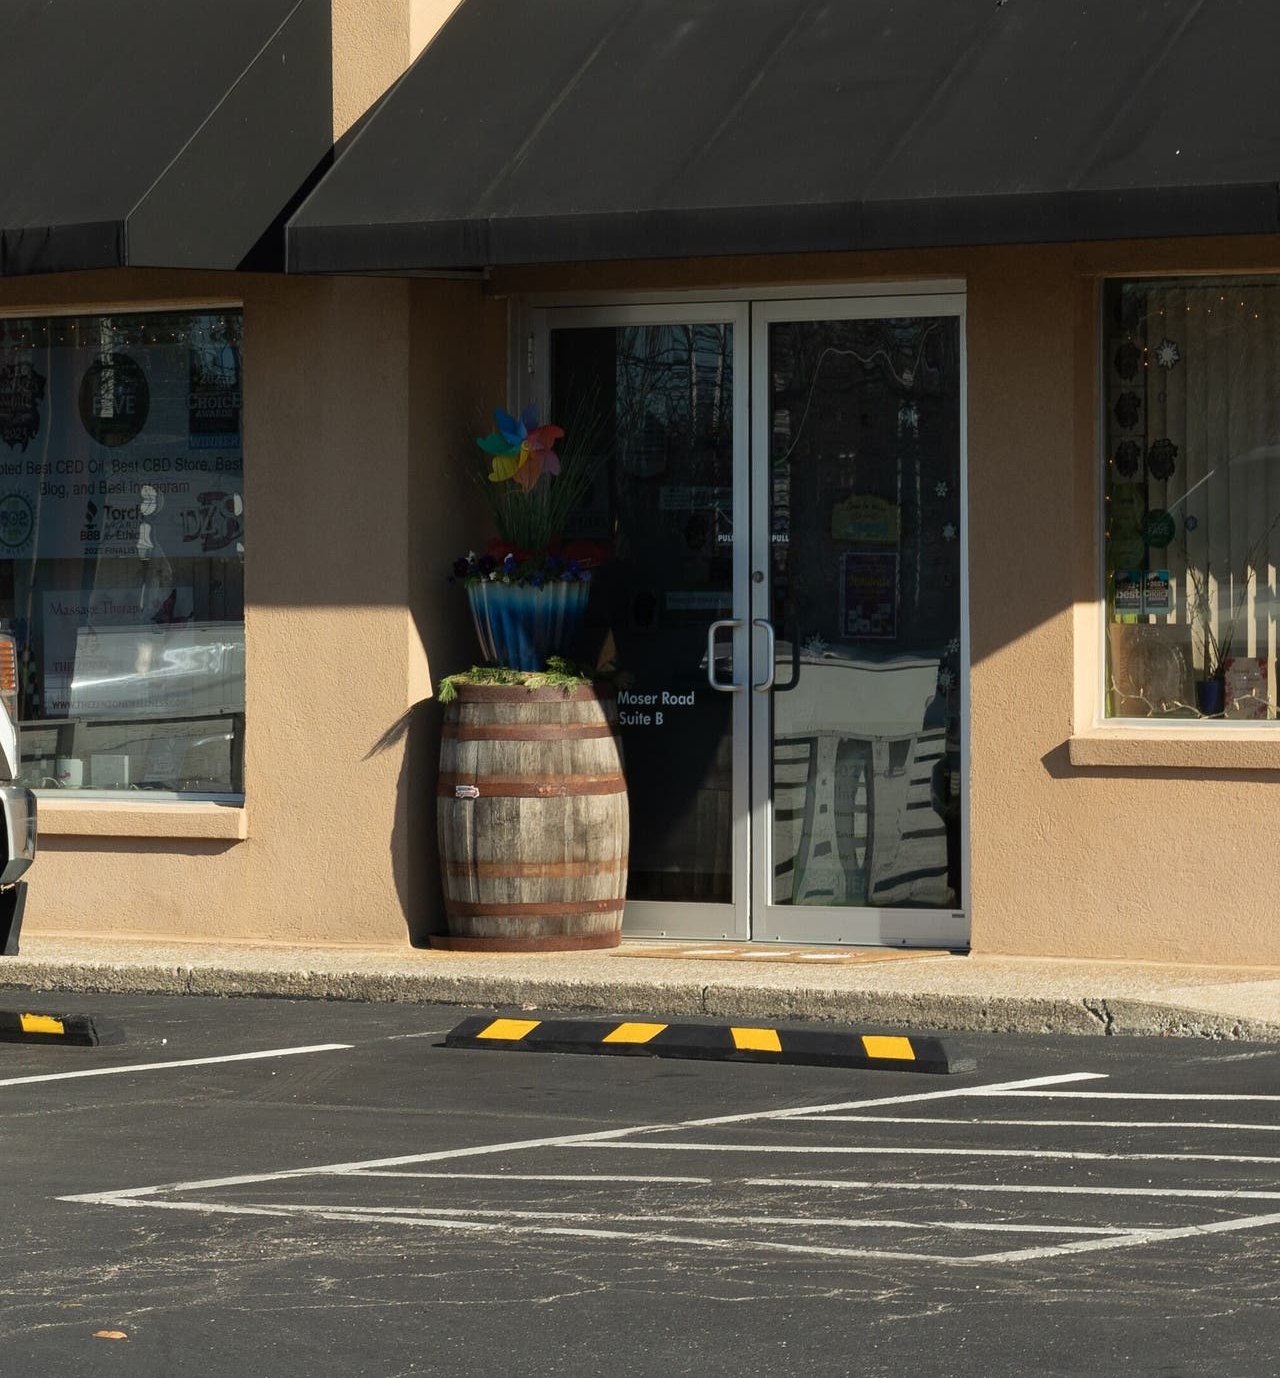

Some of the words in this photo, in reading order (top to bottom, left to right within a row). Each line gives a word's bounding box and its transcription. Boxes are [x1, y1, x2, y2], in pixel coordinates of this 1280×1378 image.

[93, 395, 137, 415] FVE
[26, 460, 52, 475] Best
[56, 460, 84, 475] CBD
[112, 458, 138, 474] Best
[143, 458, 171, 472] CBD
[215, 456, 243, 471] Best
[40, 481, 69, 499] Blog,
[73, 481, 95, 496] and
[100, 480, 125, 495] Best
[80, 530, 101, 541] BBB
[116, 530, 141, 540] Ethic
[771, 534, 790, 542] PULL
[617, 690, 658, 705] Moser
[662, 690, 696, 705] Road
[619, 710, 652, 725] Suite
[655, 711, 665, 725] B
